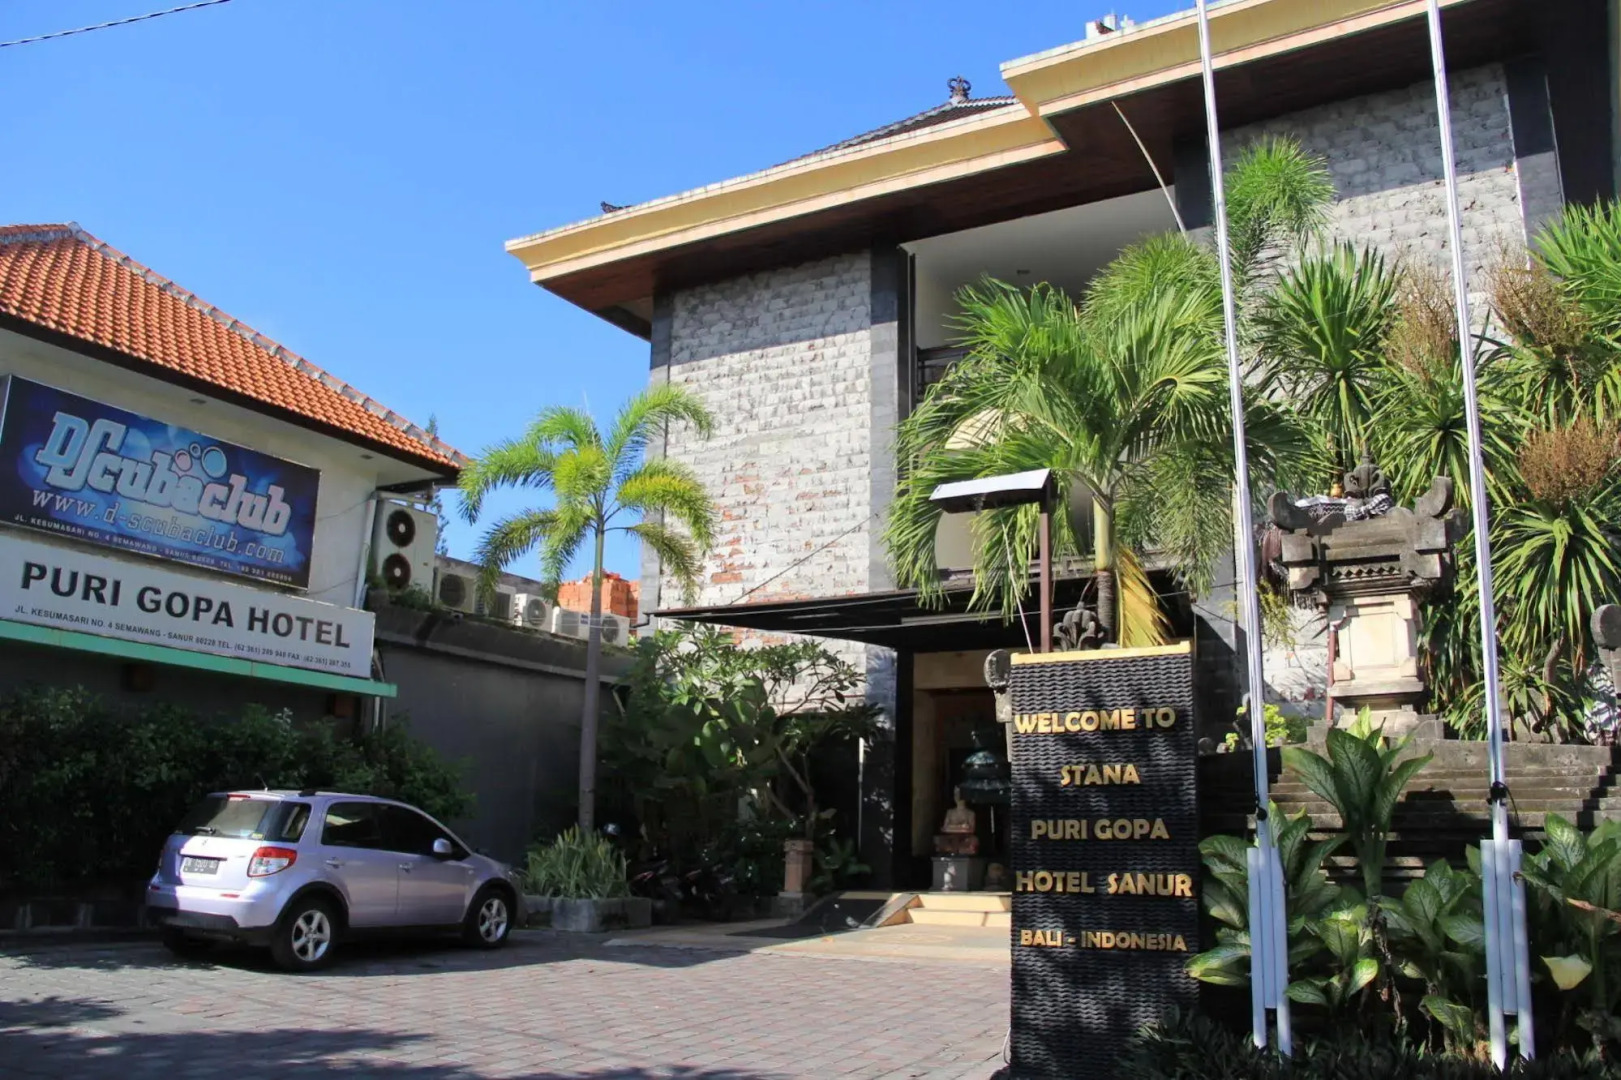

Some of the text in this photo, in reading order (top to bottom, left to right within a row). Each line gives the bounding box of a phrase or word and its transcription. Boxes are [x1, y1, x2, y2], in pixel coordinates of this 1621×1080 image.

[14, 513, 27, 523] JL.
[31, 517, 85, 536] KESUMASARI
[32, 489, 285, 563] www.d-scubaclub.com
[21, 561, 350, 648] PURI GOPA HOTEL
[15, 605, 28, 615] JL.
[31, 608, 89, 625] KESUMASARI
[91, 618, 104, 628] NO.
[115, 622, 161, 637] SEMAWANG
[167, 631, 193, 643] SANUR
[1014, 707, 1176, 734] WELCOME TO
[1060, 764, 1141, 787] STANA
[1031, 818, 1170, 840] PURI GOPA
[1015, 870, 1193, 897] HOTEL SANUR
[1020, 929, 1062, 947] BALI
[1081, 930, 1187, 952] INDONESIA
